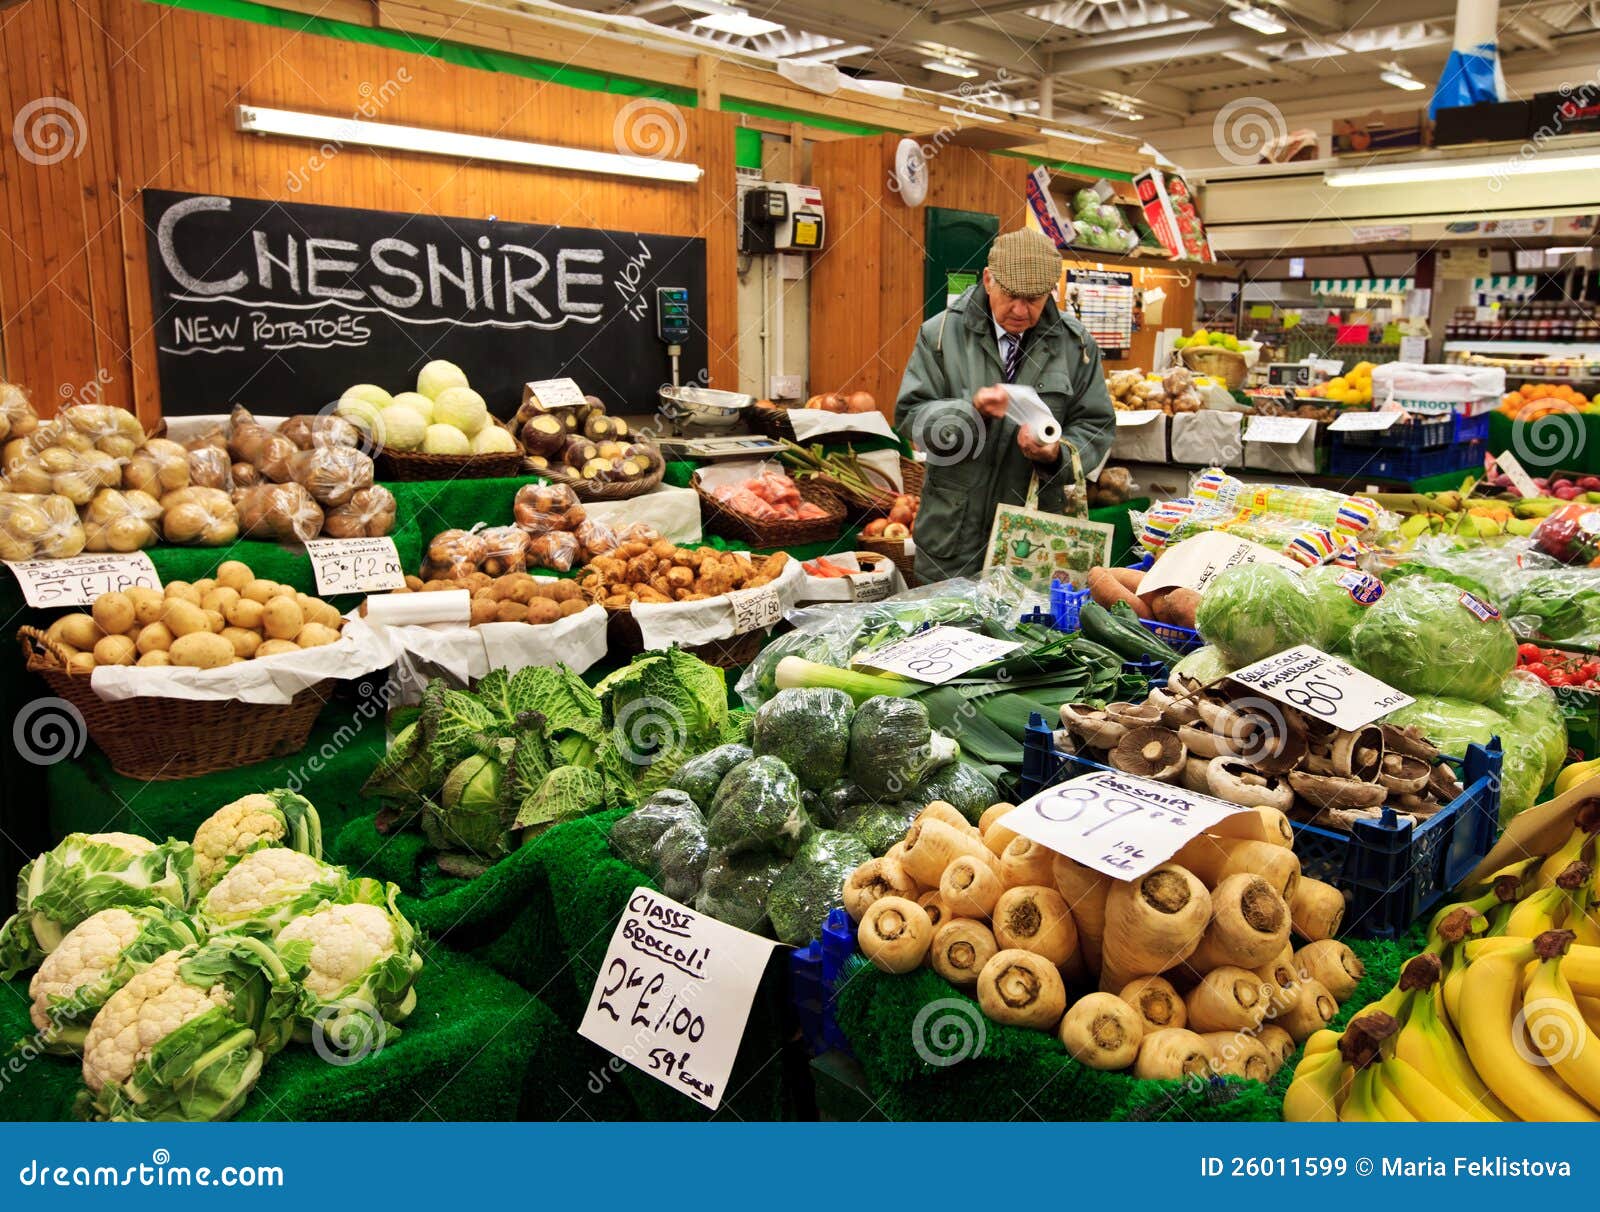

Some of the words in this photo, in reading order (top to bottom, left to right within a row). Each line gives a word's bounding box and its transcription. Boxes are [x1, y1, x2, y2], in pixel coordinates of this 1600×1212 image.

[614, 239, 652, 302] NOW
[174, 316, 240, 344] NEW
[250, 312, 371, 342] POTATOES
